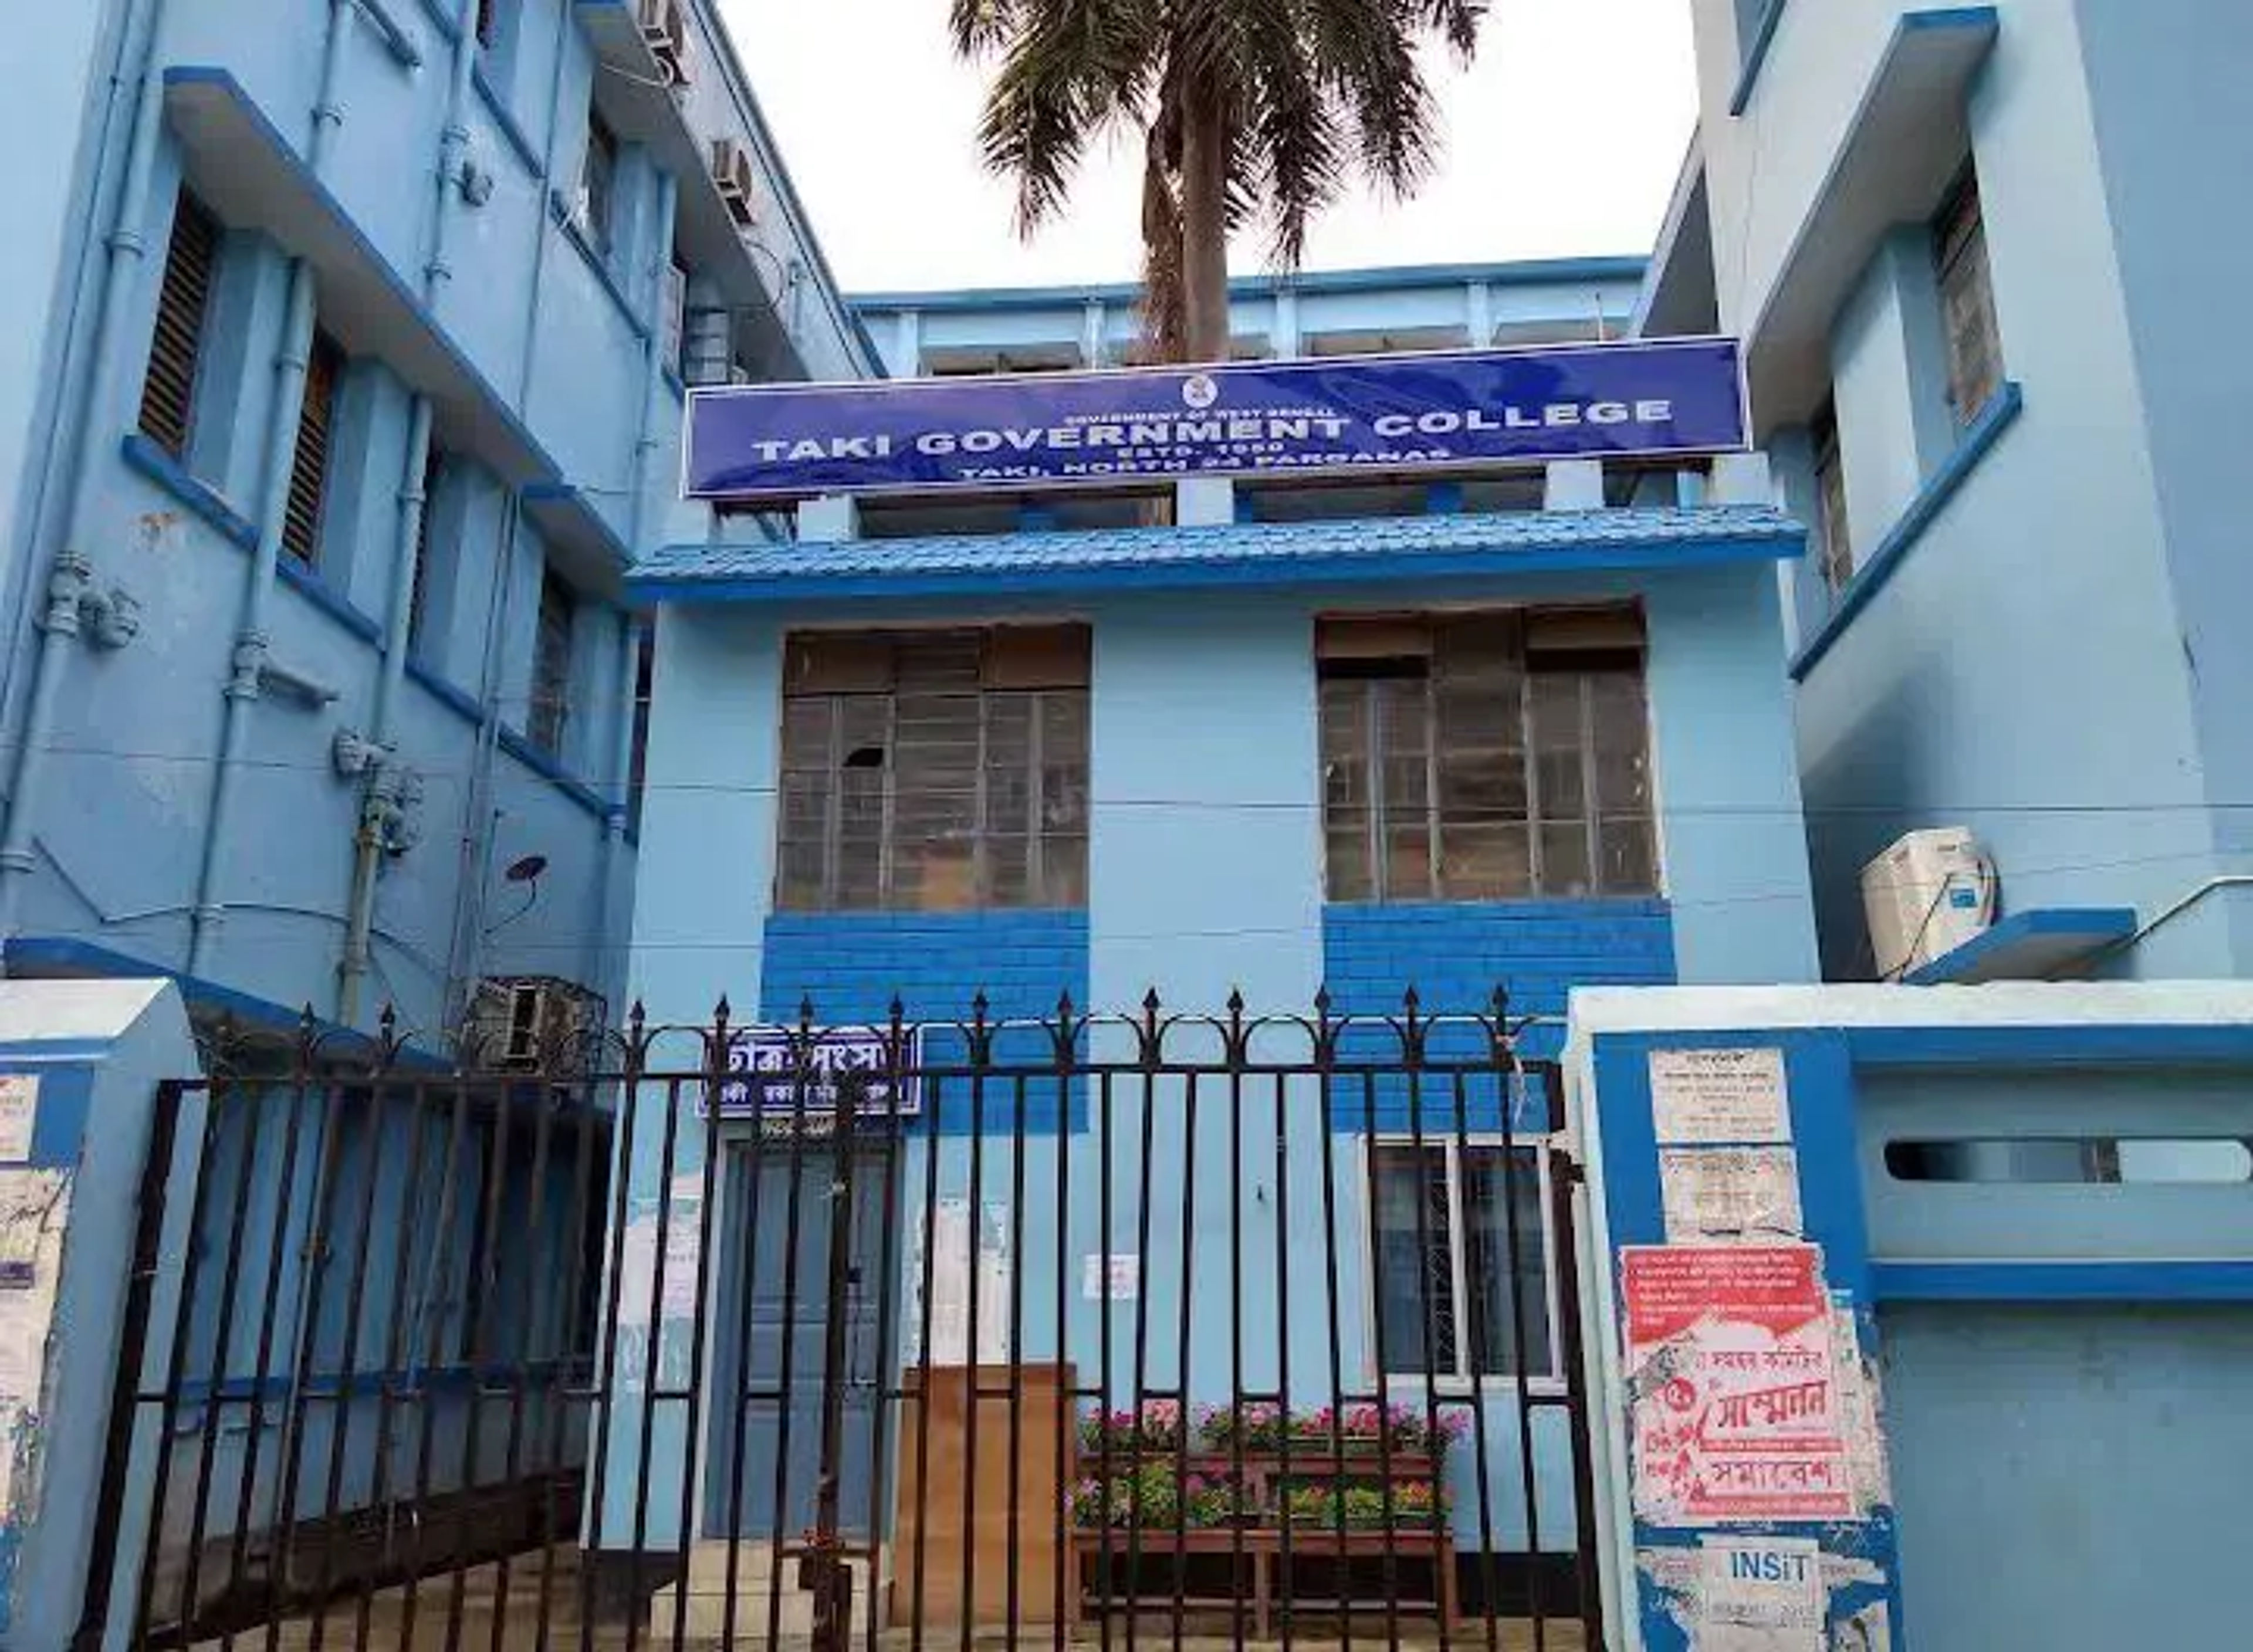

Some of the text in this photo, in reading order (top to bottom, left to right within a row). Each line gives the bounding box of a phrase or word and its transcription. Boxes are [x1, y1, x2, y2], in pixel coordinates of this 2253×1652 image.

[1065, 407, 1336, 424] GOVERNMENT OF WEST BENGAL
[752, 400, 1672, 461] TAKI GOVERNMENT COLLEGE
[1063, 460, 1186, 473] NORTH
[1255, 450, 1450, 465] PARGANAS
